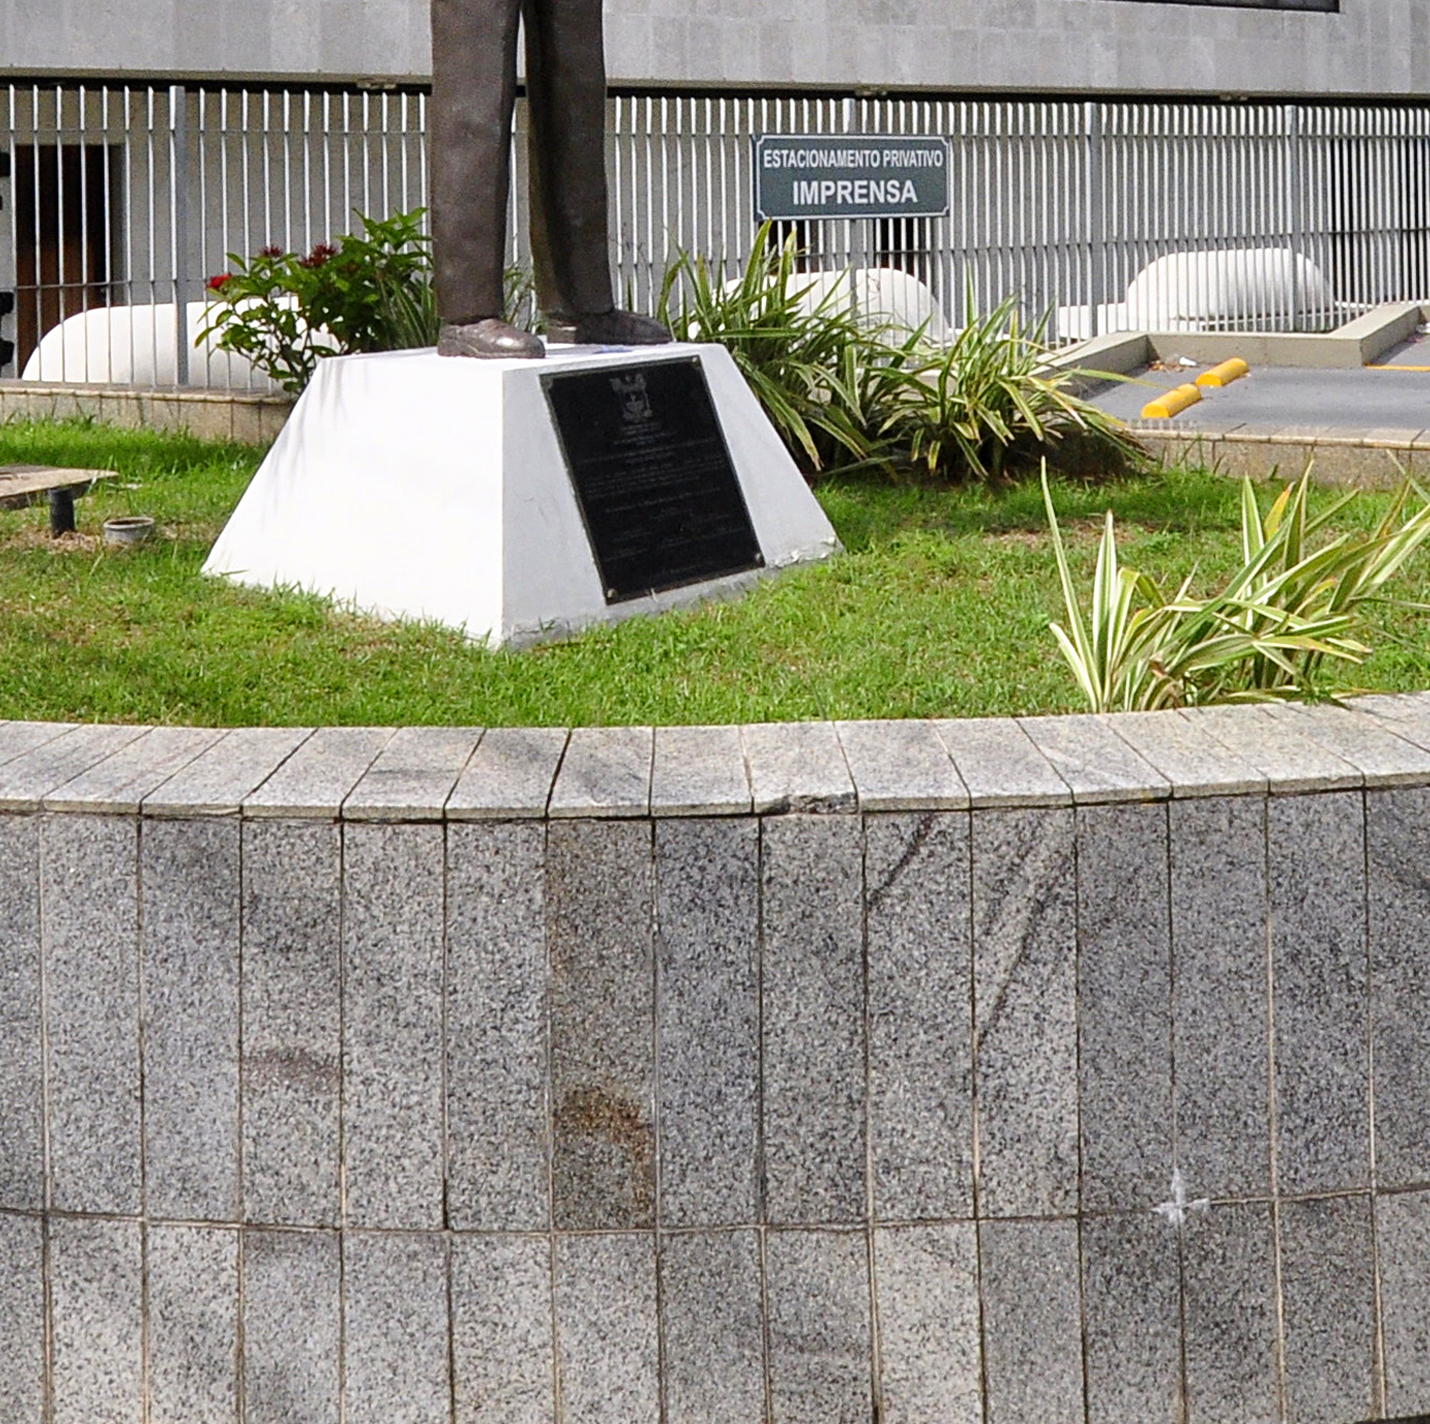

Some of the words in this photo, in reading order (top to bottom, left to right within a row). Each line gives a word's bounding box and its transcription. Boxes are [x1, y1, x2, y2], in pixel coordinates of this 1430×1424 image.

[763, 149, 881, 168] ESTACIONAMENTO
[882, 149, 943, 167] PRIVATIVO
[792, 179, 918, 205] IMPRENSA
